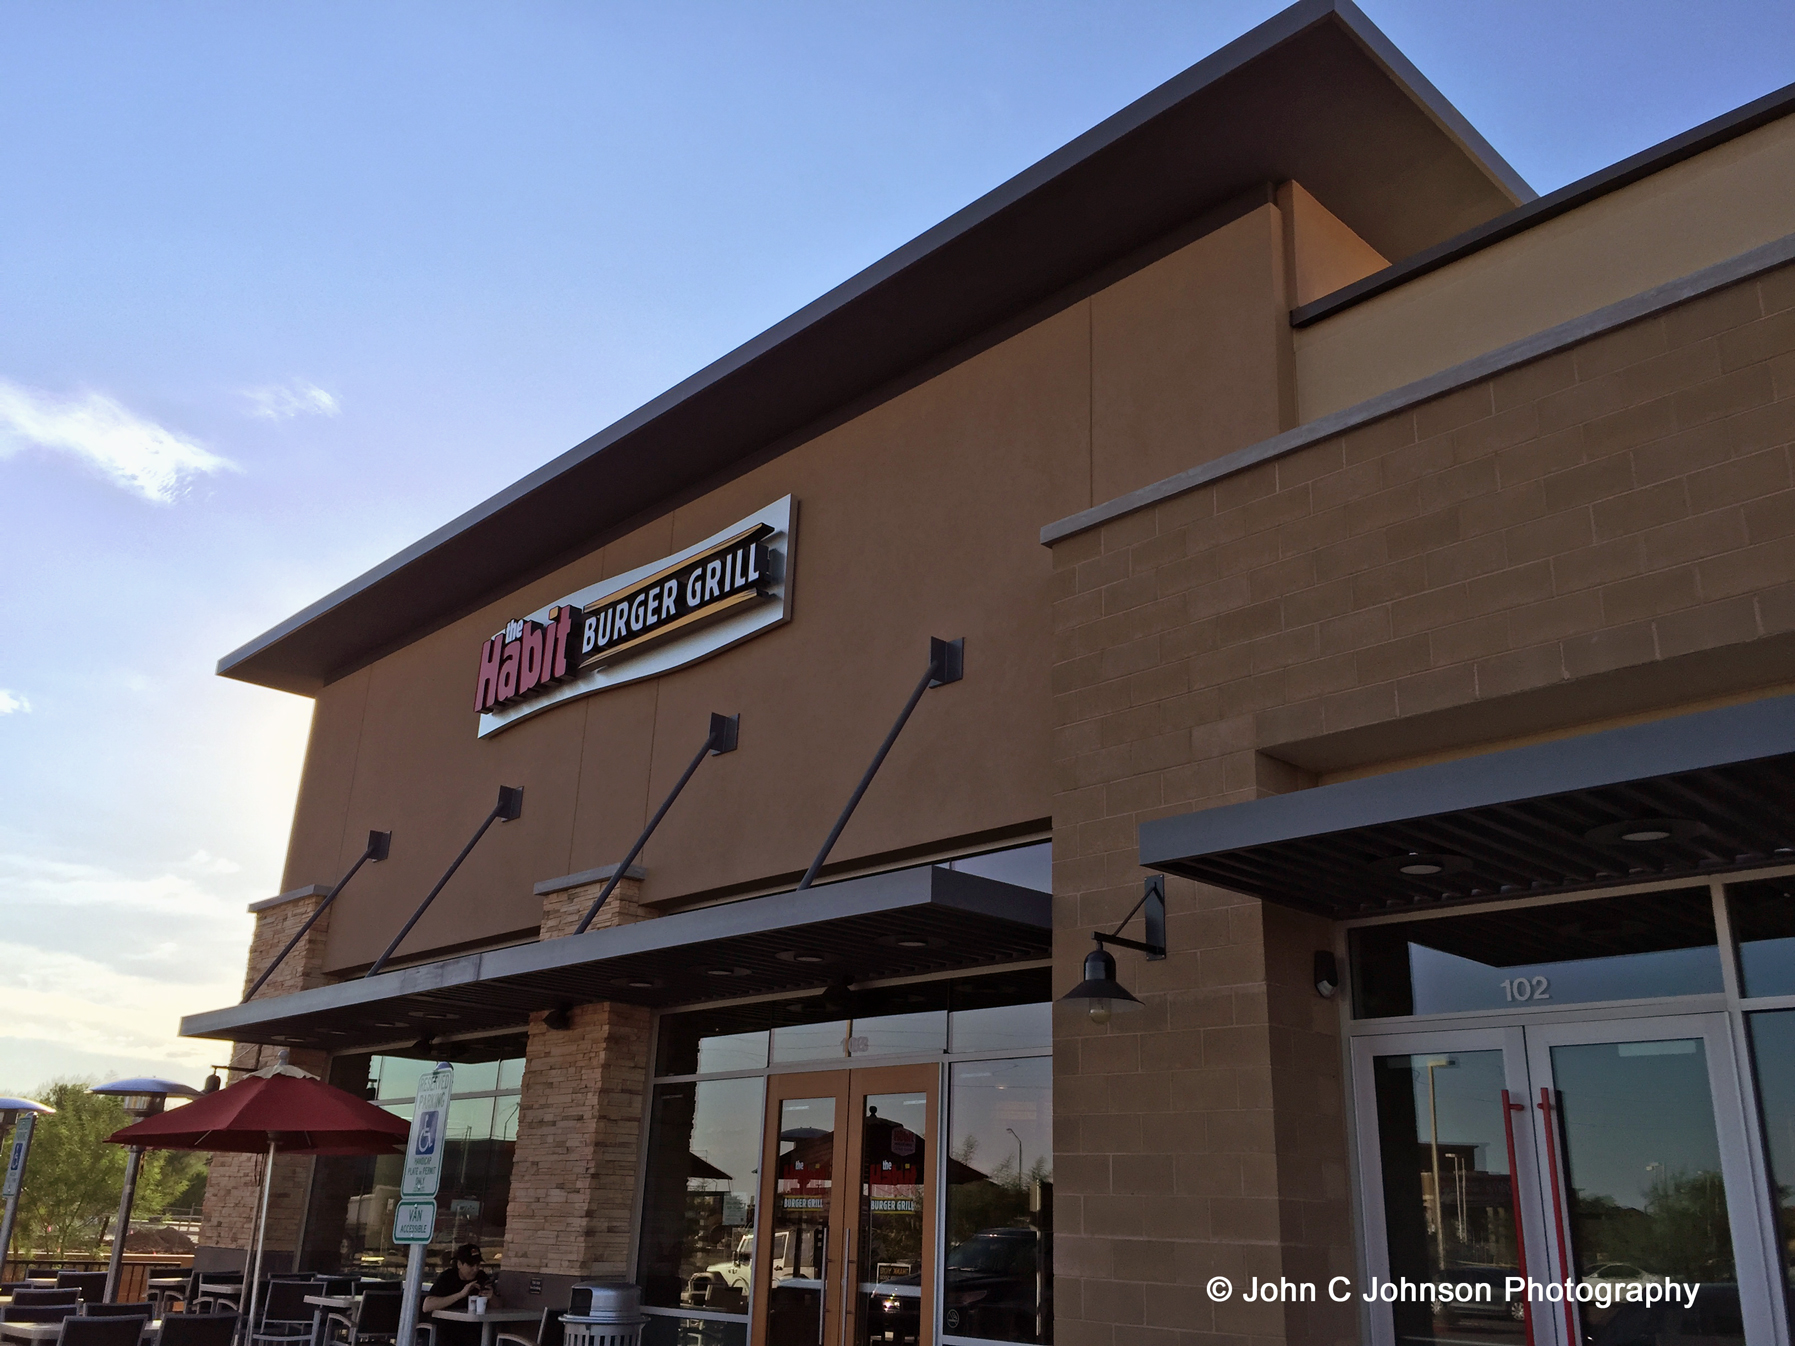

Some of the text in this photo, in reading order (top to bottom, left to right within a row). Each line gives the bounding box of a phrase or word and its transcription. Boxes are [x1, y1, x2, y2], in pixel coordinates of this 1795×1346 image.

[473, 542, 760, 713] Habit BURGER GRILL
[505, 619, 524, 644] the
[1500, 975, 1551, 1002] 102
[419, 1073, 450, 1092] RESERVED
[418, 1092, 446, 1110] PARKING
[795, 1160, 804, 1170] the
[882, 1160, 892, 1171] the
[783, 1198, 824, 1209] BURGER GRILL
[870, 1200, 915, 1211] BURGER GRILL
[408, 1209, 423, 1222] VAN
[400, 1224, 428, 1234] ACCESSIBLE
